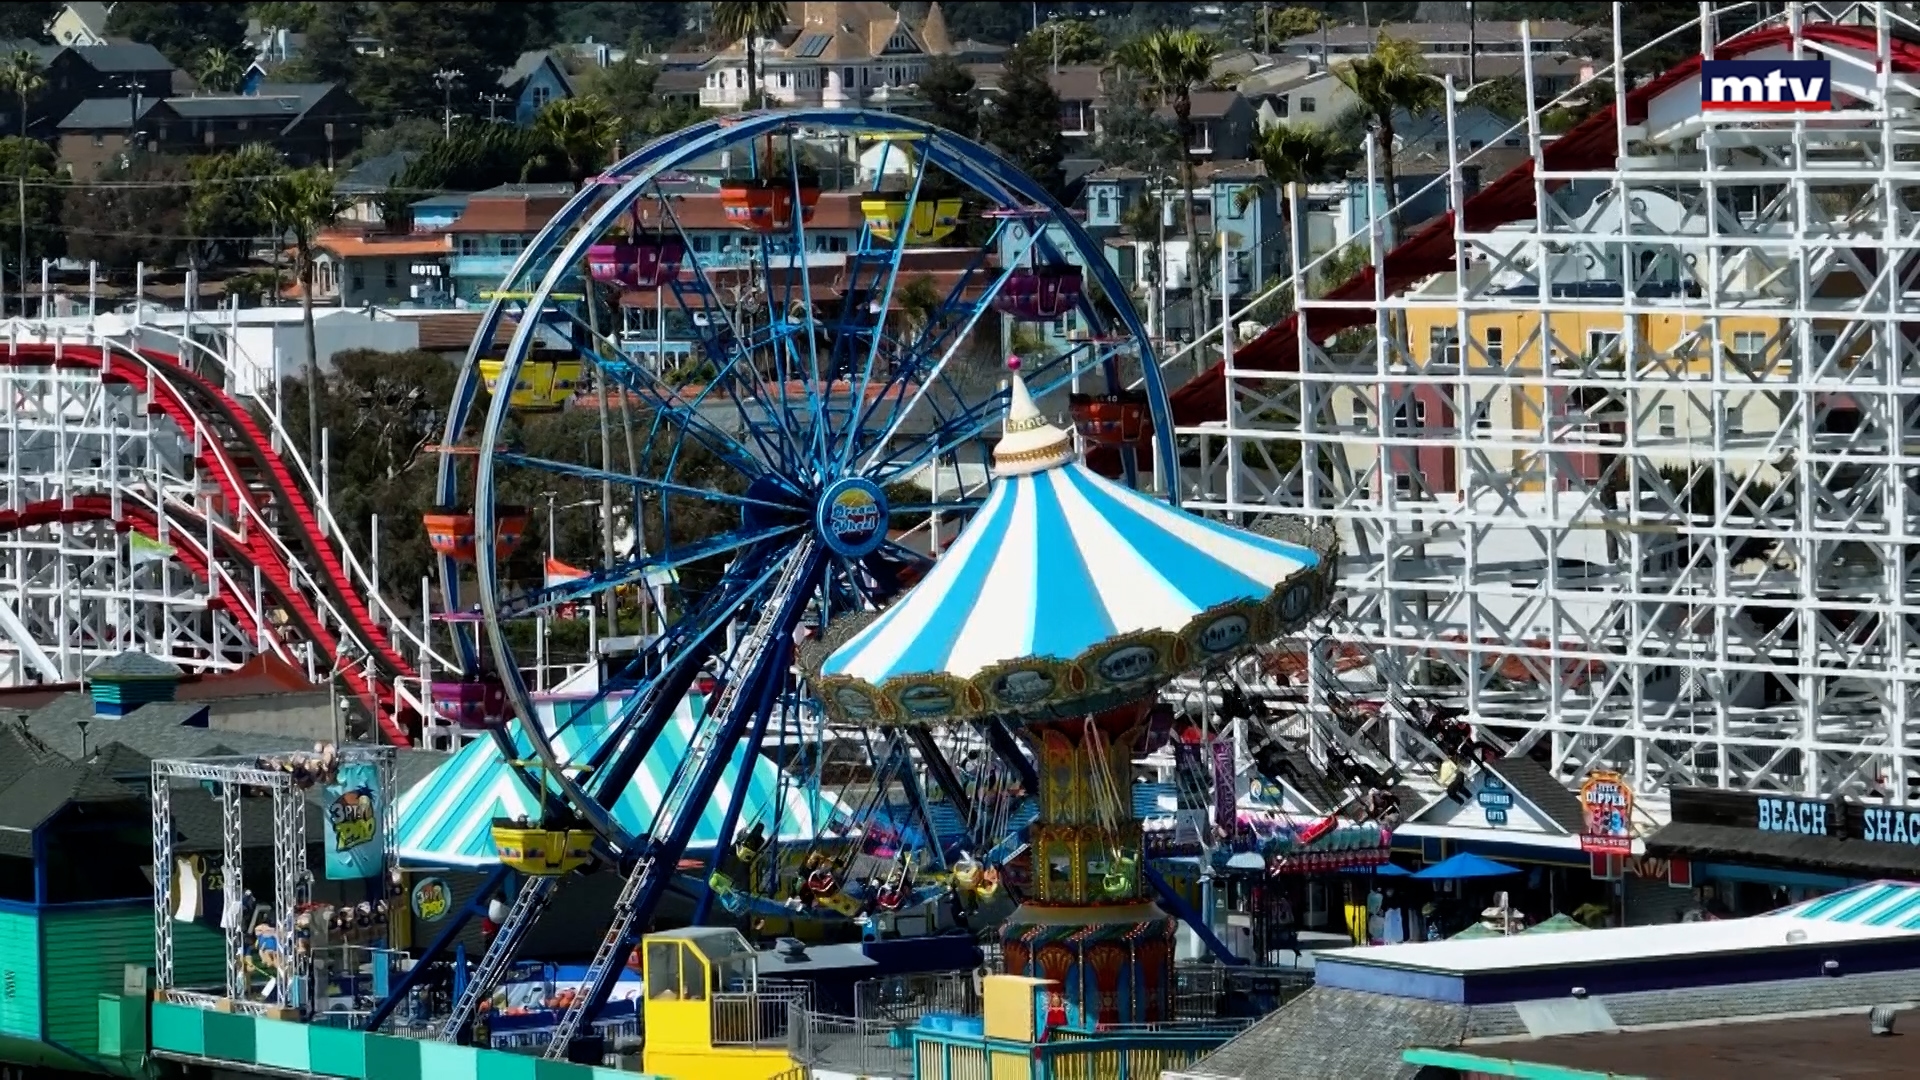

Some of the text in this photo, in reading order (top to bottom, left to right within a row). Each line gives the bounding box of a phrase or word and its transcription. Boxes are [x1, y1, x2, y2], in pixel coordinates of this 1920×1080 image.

[411, 265, 441, 276] MOTEL
[832, 501, 878, 519] Dream
[831, 515, 876, 539] Wheel
[1479, 793, 1510, 804] SOUVENIRS
[1586, 792, 1626, 806] DIPPER
[1758, 798, 1827, 836] BEACH
[1863, 809, 1920, 846] SHAC
[208, 876, 224, 890] 23
